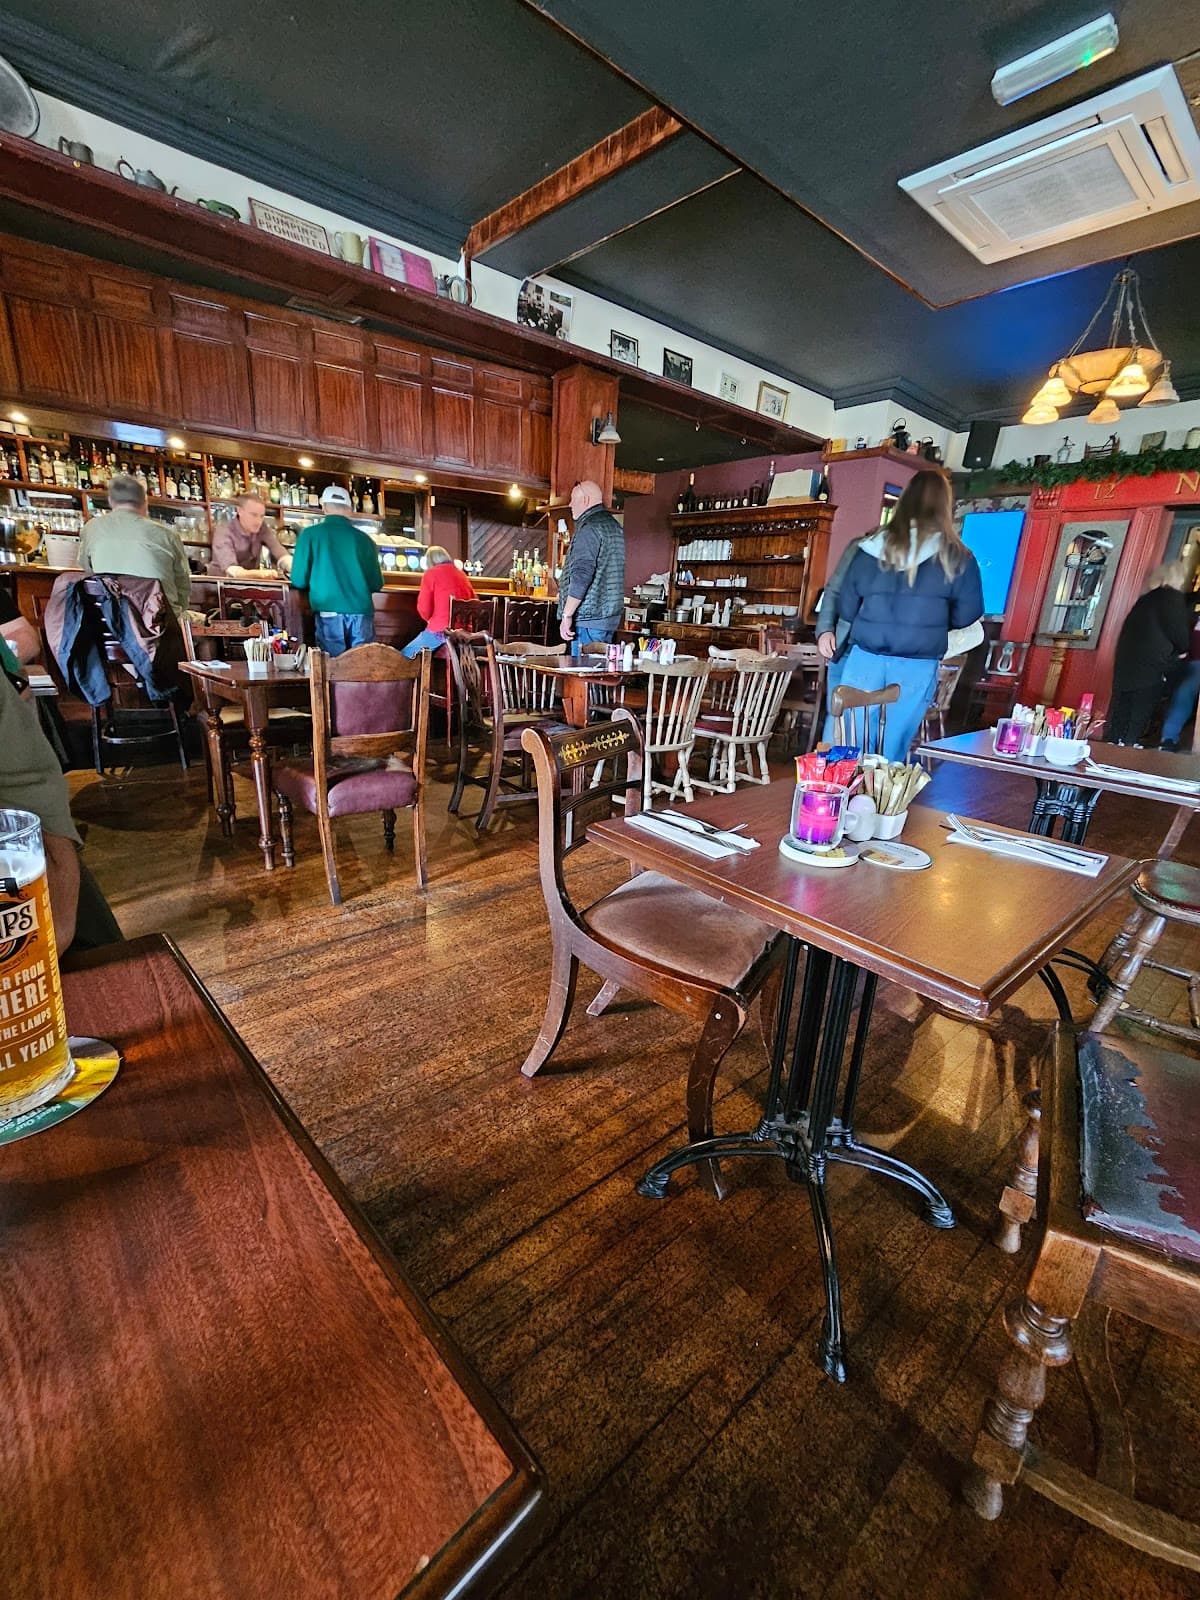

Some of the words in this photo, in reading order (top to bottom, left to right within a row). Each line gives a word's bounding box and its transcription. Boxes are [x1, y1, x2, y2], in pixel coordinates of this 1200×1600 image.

[258, 219, 326, 251] PROHIBITED
[264, 212, 318, 239] DUMPING
[1094, 483, 1116, 500] 12
[0, 904, 33, 938] PS
[14, 960, 46, 986] FROM
[20, 1007, 52, 1033] LAMPS
